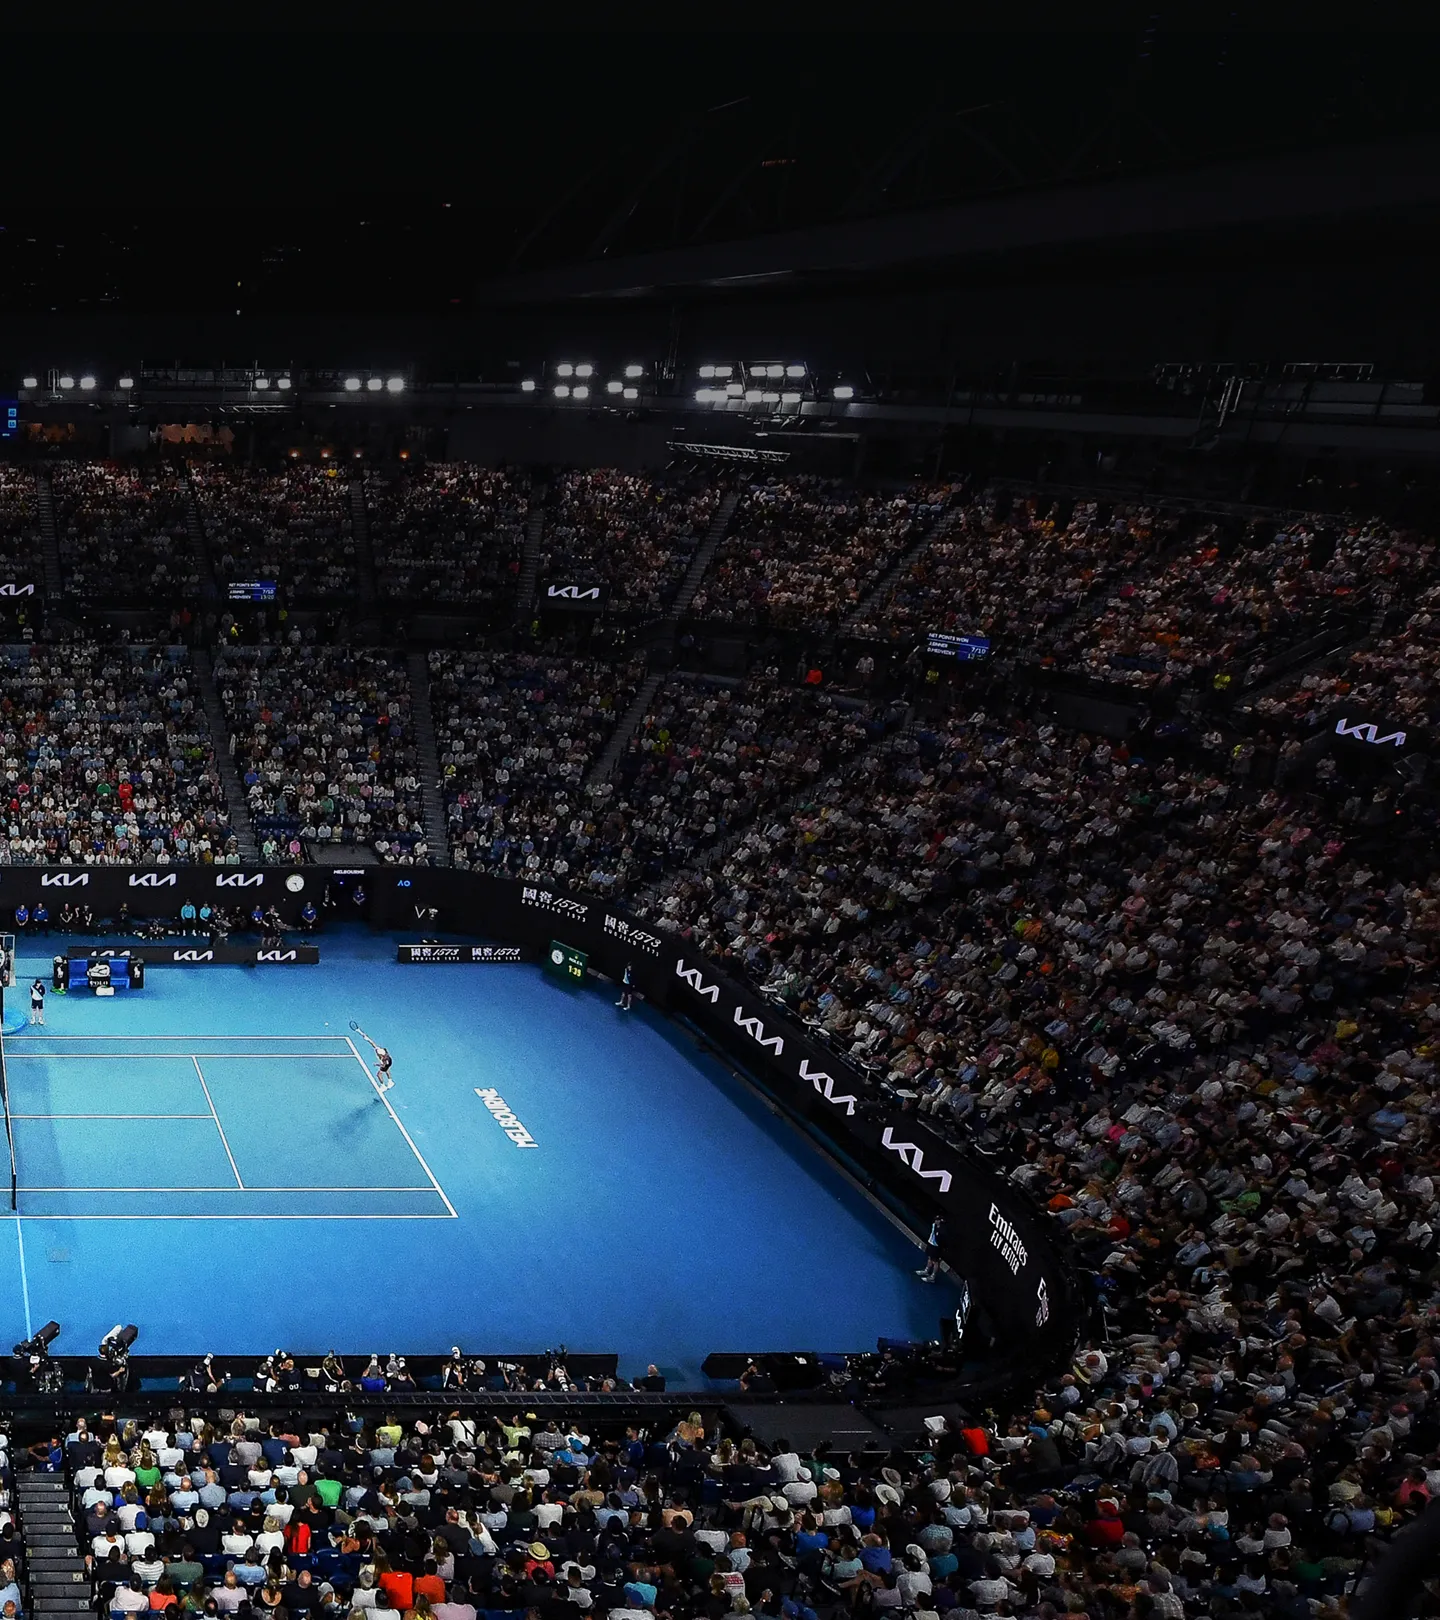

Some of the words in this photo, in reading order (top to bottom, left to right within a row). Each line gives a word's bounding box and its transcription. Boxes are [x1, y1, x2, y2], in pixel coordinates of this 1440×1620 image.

[547, 583, 599, 600] KIA
[1335, 717, 1415, 747] KIA
[41, 873, 88, 886] KIA
[129, 873, 176, 886] KIA
[216, 873, 263, 886] KIA
[174, 950, 213, 961] KIA
[257, 950, 296, 961] KIA
[675, 958, 720, 1004] KIA
[734, 1005, 784, 1056] KIA
[799, 1059, 856, 1116] KIA
[473, 1087, 539, 1148] MELBOURNE
[881, 1126, 952, 1193] KIA
[988, 1202, 1029, 1267] Emirates
[990, 1229, 1002, 1249] FLY
[1001, 1242, 1020, 1276] BETTER
